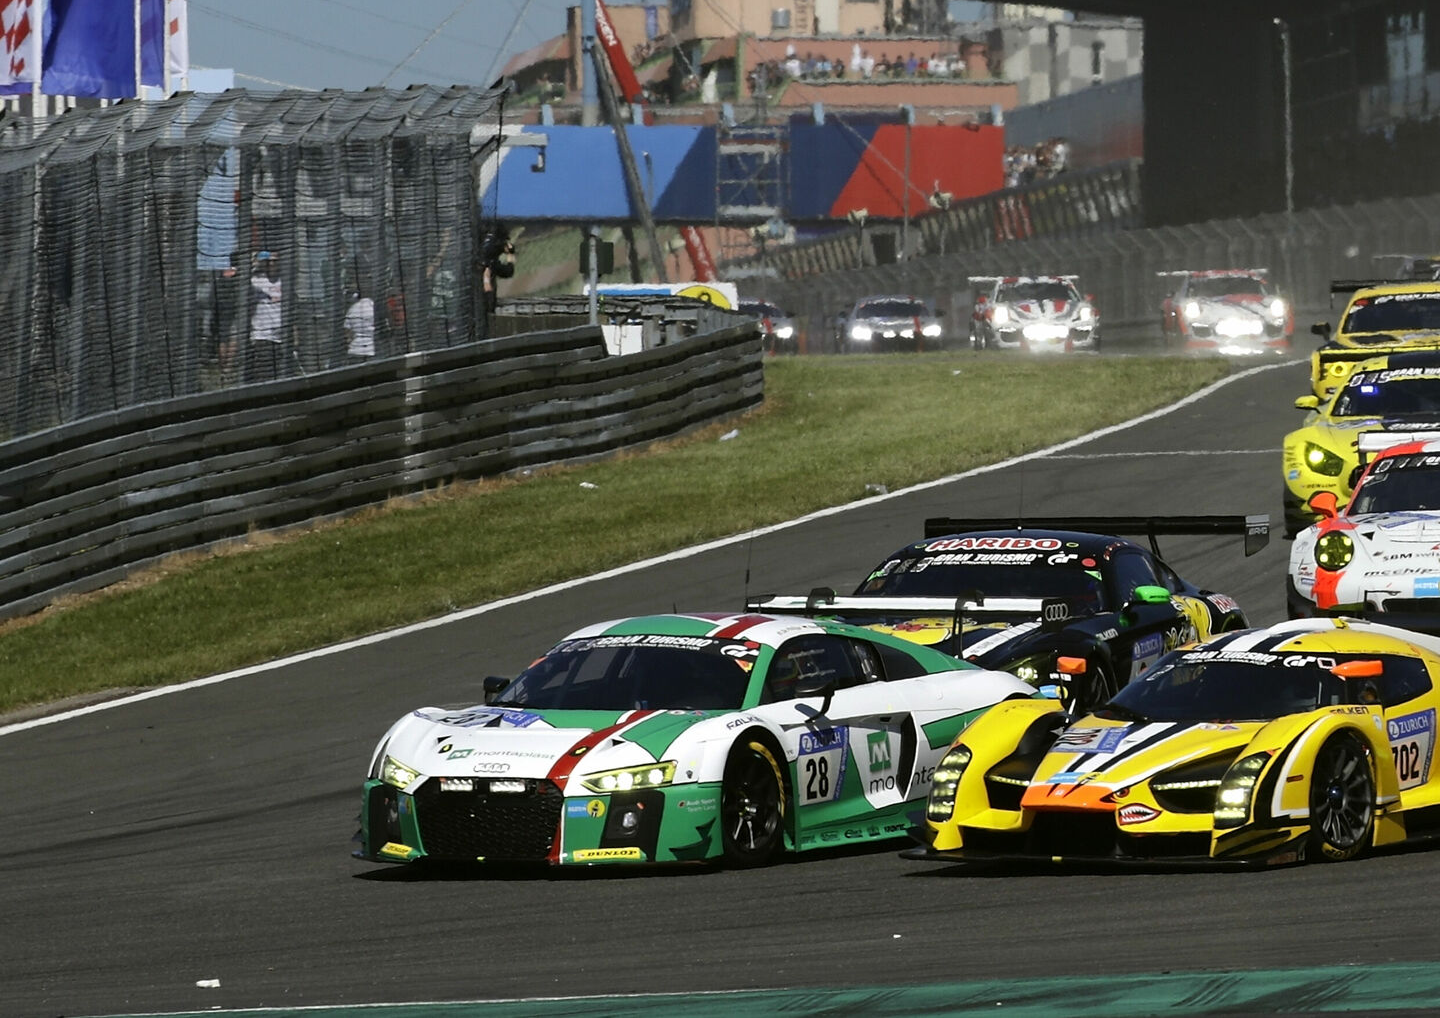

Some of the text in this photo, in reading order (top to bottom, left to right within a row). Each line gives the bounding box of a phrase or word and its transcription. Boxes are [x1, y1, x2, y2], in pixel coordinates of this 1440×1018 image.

[926, 538, 1060, 551] HARIBO
[933, 553, 969, 562] GRAN
[973, 553, 1038, 562] TURISMO
[1383, 552, 1413, 562] SBM
[598, 635, 640, 645] GRAN
[644, 635, 712, 647] TURISMO
[1182, 650, 1218, 660] GRAN
[1217, 651, 1279, 663] TURISMO
[1399, 715, 1429, 734] ZURICH
[806, 756, 829, 800] 28
